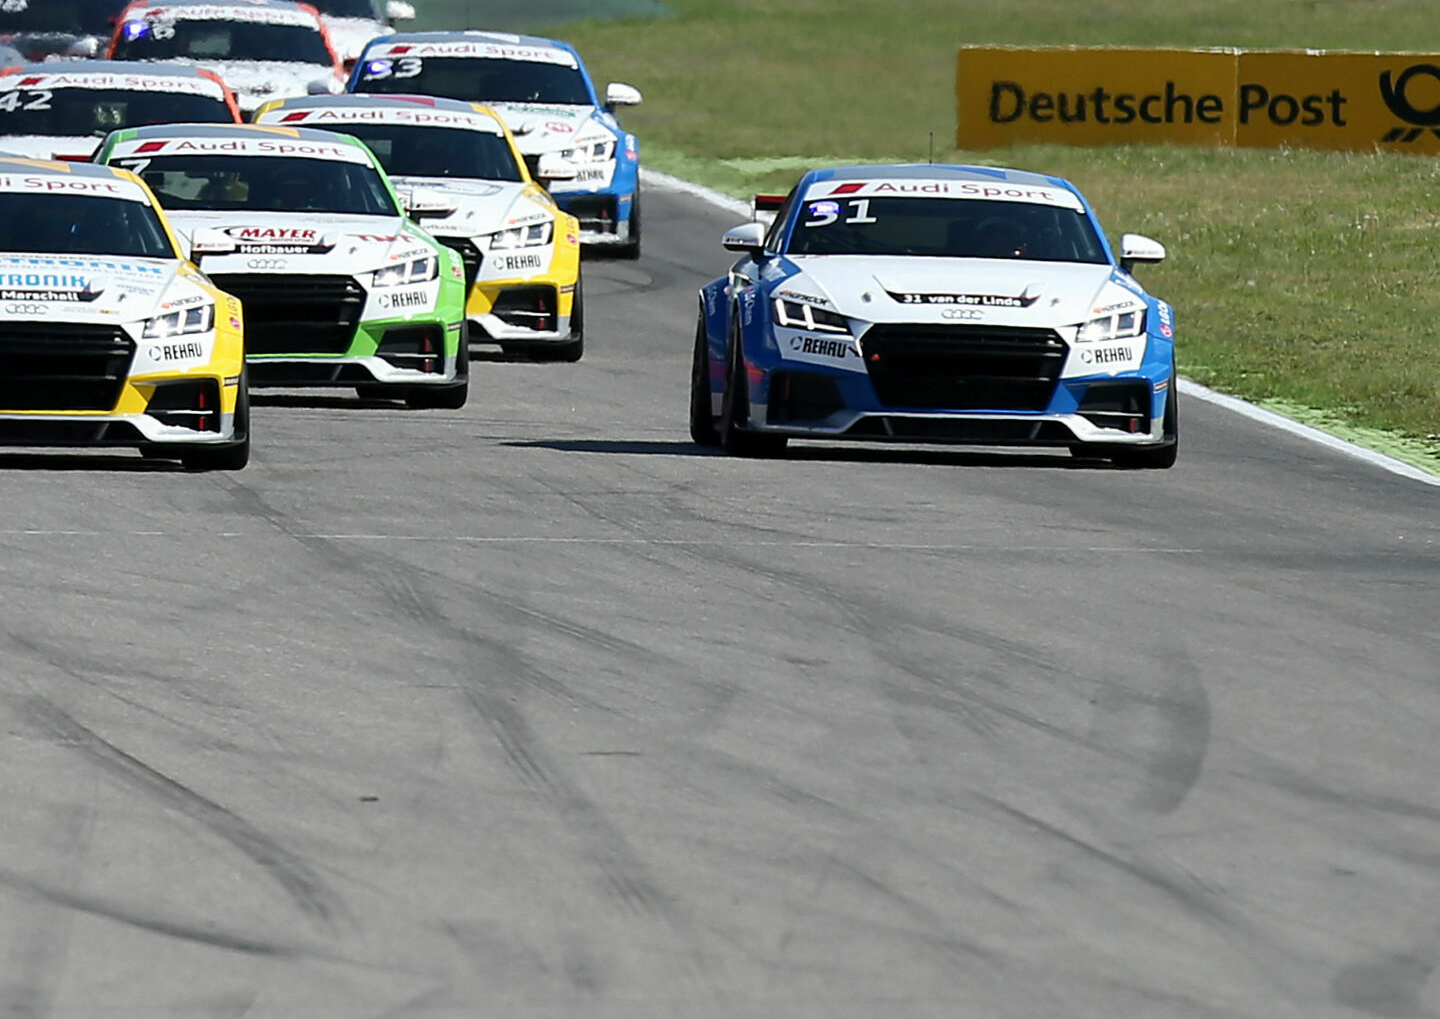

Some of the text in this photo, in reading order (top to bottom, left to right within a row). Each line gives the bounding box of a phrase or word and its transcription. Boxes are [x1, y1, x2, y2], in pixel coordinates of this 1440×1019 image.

[418, 44, 558, 59] Audi Sport
[51, 75, 203, 90] Audi Sport
[989, 81, 1348, 127] Deutsche Post
[317, 110, 479, 126] Audi Sport
[175, 140, 347, 157] Audi Sport
[23, 177, 121, 193] Sport
[873, 182, 1055, 201] Audi Sport
[804, 198, 878, 228] 31
[239, 228, 317, 239] MAYER
[239, 244, 311, 255] Hofbauer
[505, 254, 542, 270] REHAU
[1, 290, 80, 301] Marschall
[391, 291, 429, 308] REHAU
[902, 294, 1022, 306] 31 van der Linde
[163, 342, 204, 361] REHAU
[802, 337, 848, 359] REHAU
[1094, 346, 1134, 364] REHAU
